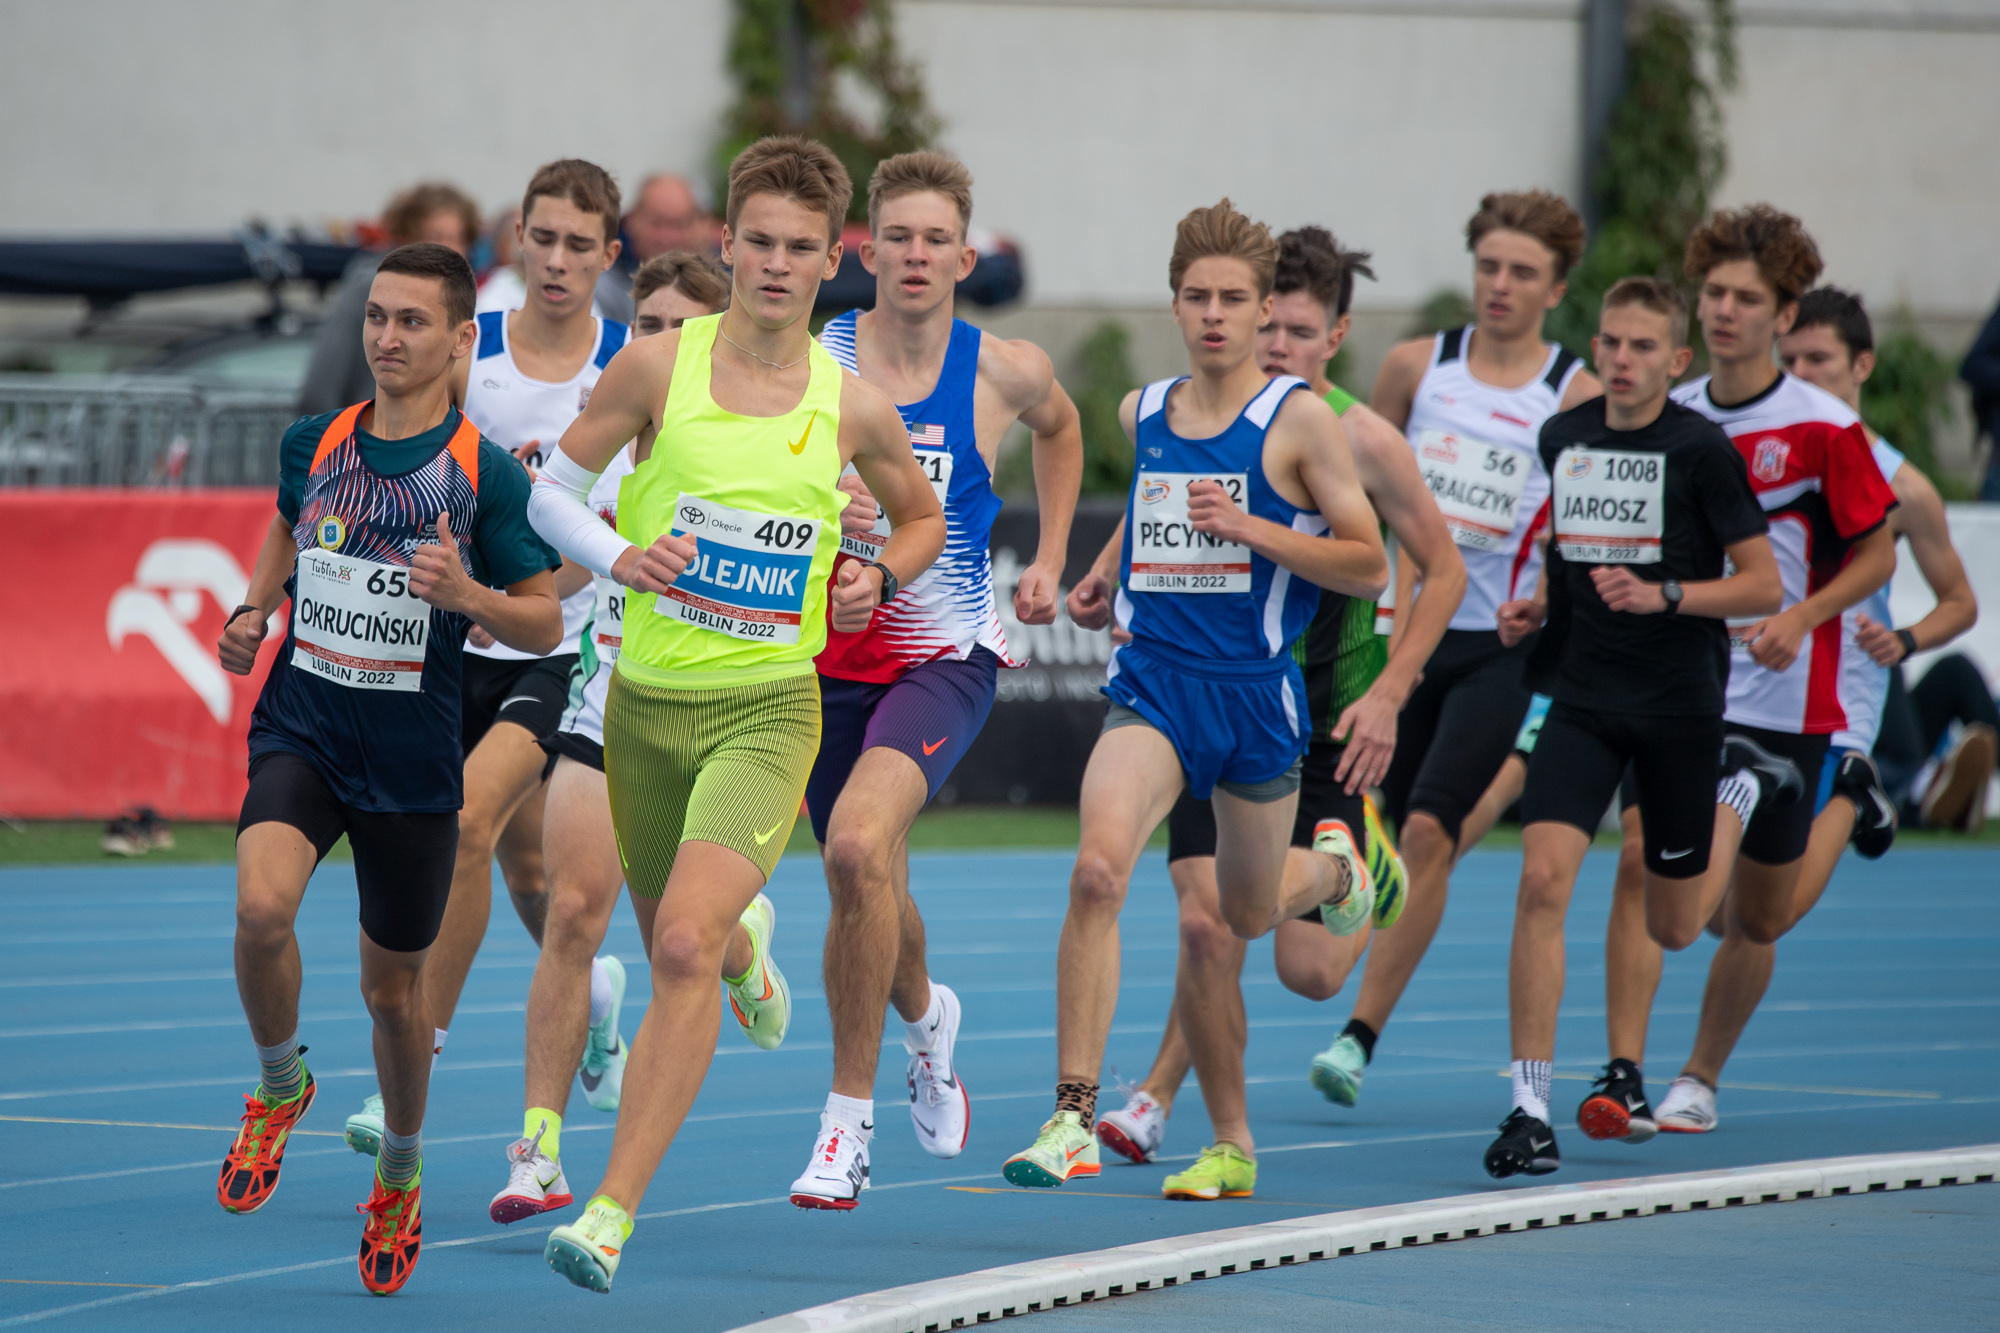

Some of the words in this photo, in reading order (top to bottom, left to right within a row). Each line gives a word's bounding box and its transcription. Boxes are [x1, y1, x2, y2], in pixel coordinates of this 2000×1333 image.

[1483, 450, 1516, 476] 56
[1605, 458, 1658, 483] 1008
[1421, 470, 1518, 517] ÓRALCZYK
[1562, 496, 1647, 524] JAROSZ
[711, 519, 742, 533] Okęcie
[754, 519, 813, 550] 409
[840, 536, 875, 558] UBLIN
[1605, 547, 1640, 559] 2022
[367, 568, 421, 599] 65
[1146, 575, 1187, 588] LUBLIN
[1191, 575, 1227, 588] 2022
[301, 597, 424, 646] OKRUCIŃSKI
[681, 605, 734, 631] LUBLIN
[738, 622, 776, 638] 2022
[312, 656, 351, 682] LUBLIN
[356, 670, 395, 684] 2022
